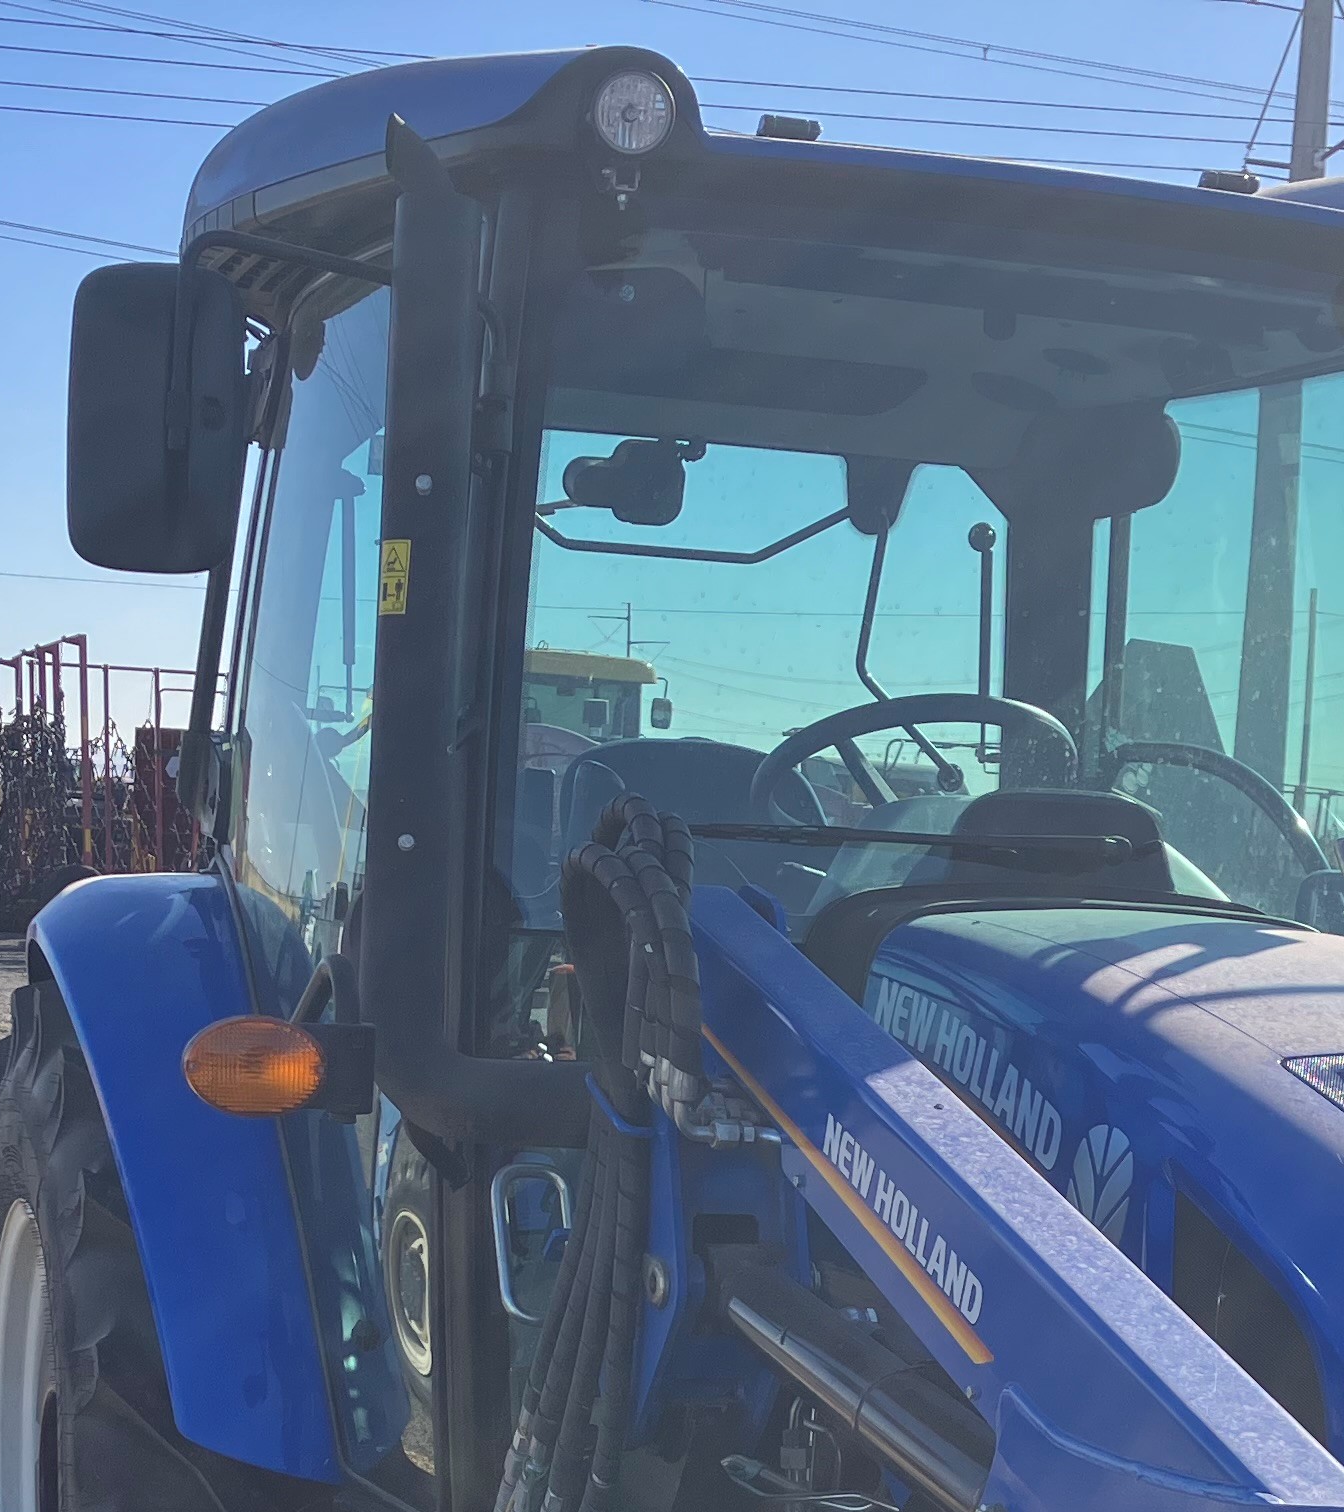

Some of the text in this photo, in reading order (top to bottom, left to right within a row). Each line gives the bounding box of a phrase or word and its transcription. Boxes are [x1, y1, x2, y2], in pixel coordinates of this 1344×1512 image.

[874, 977, 1062, 1171] NEW HOLLAND
[823, 1113, 983, 1325] NEW HOLLAND
